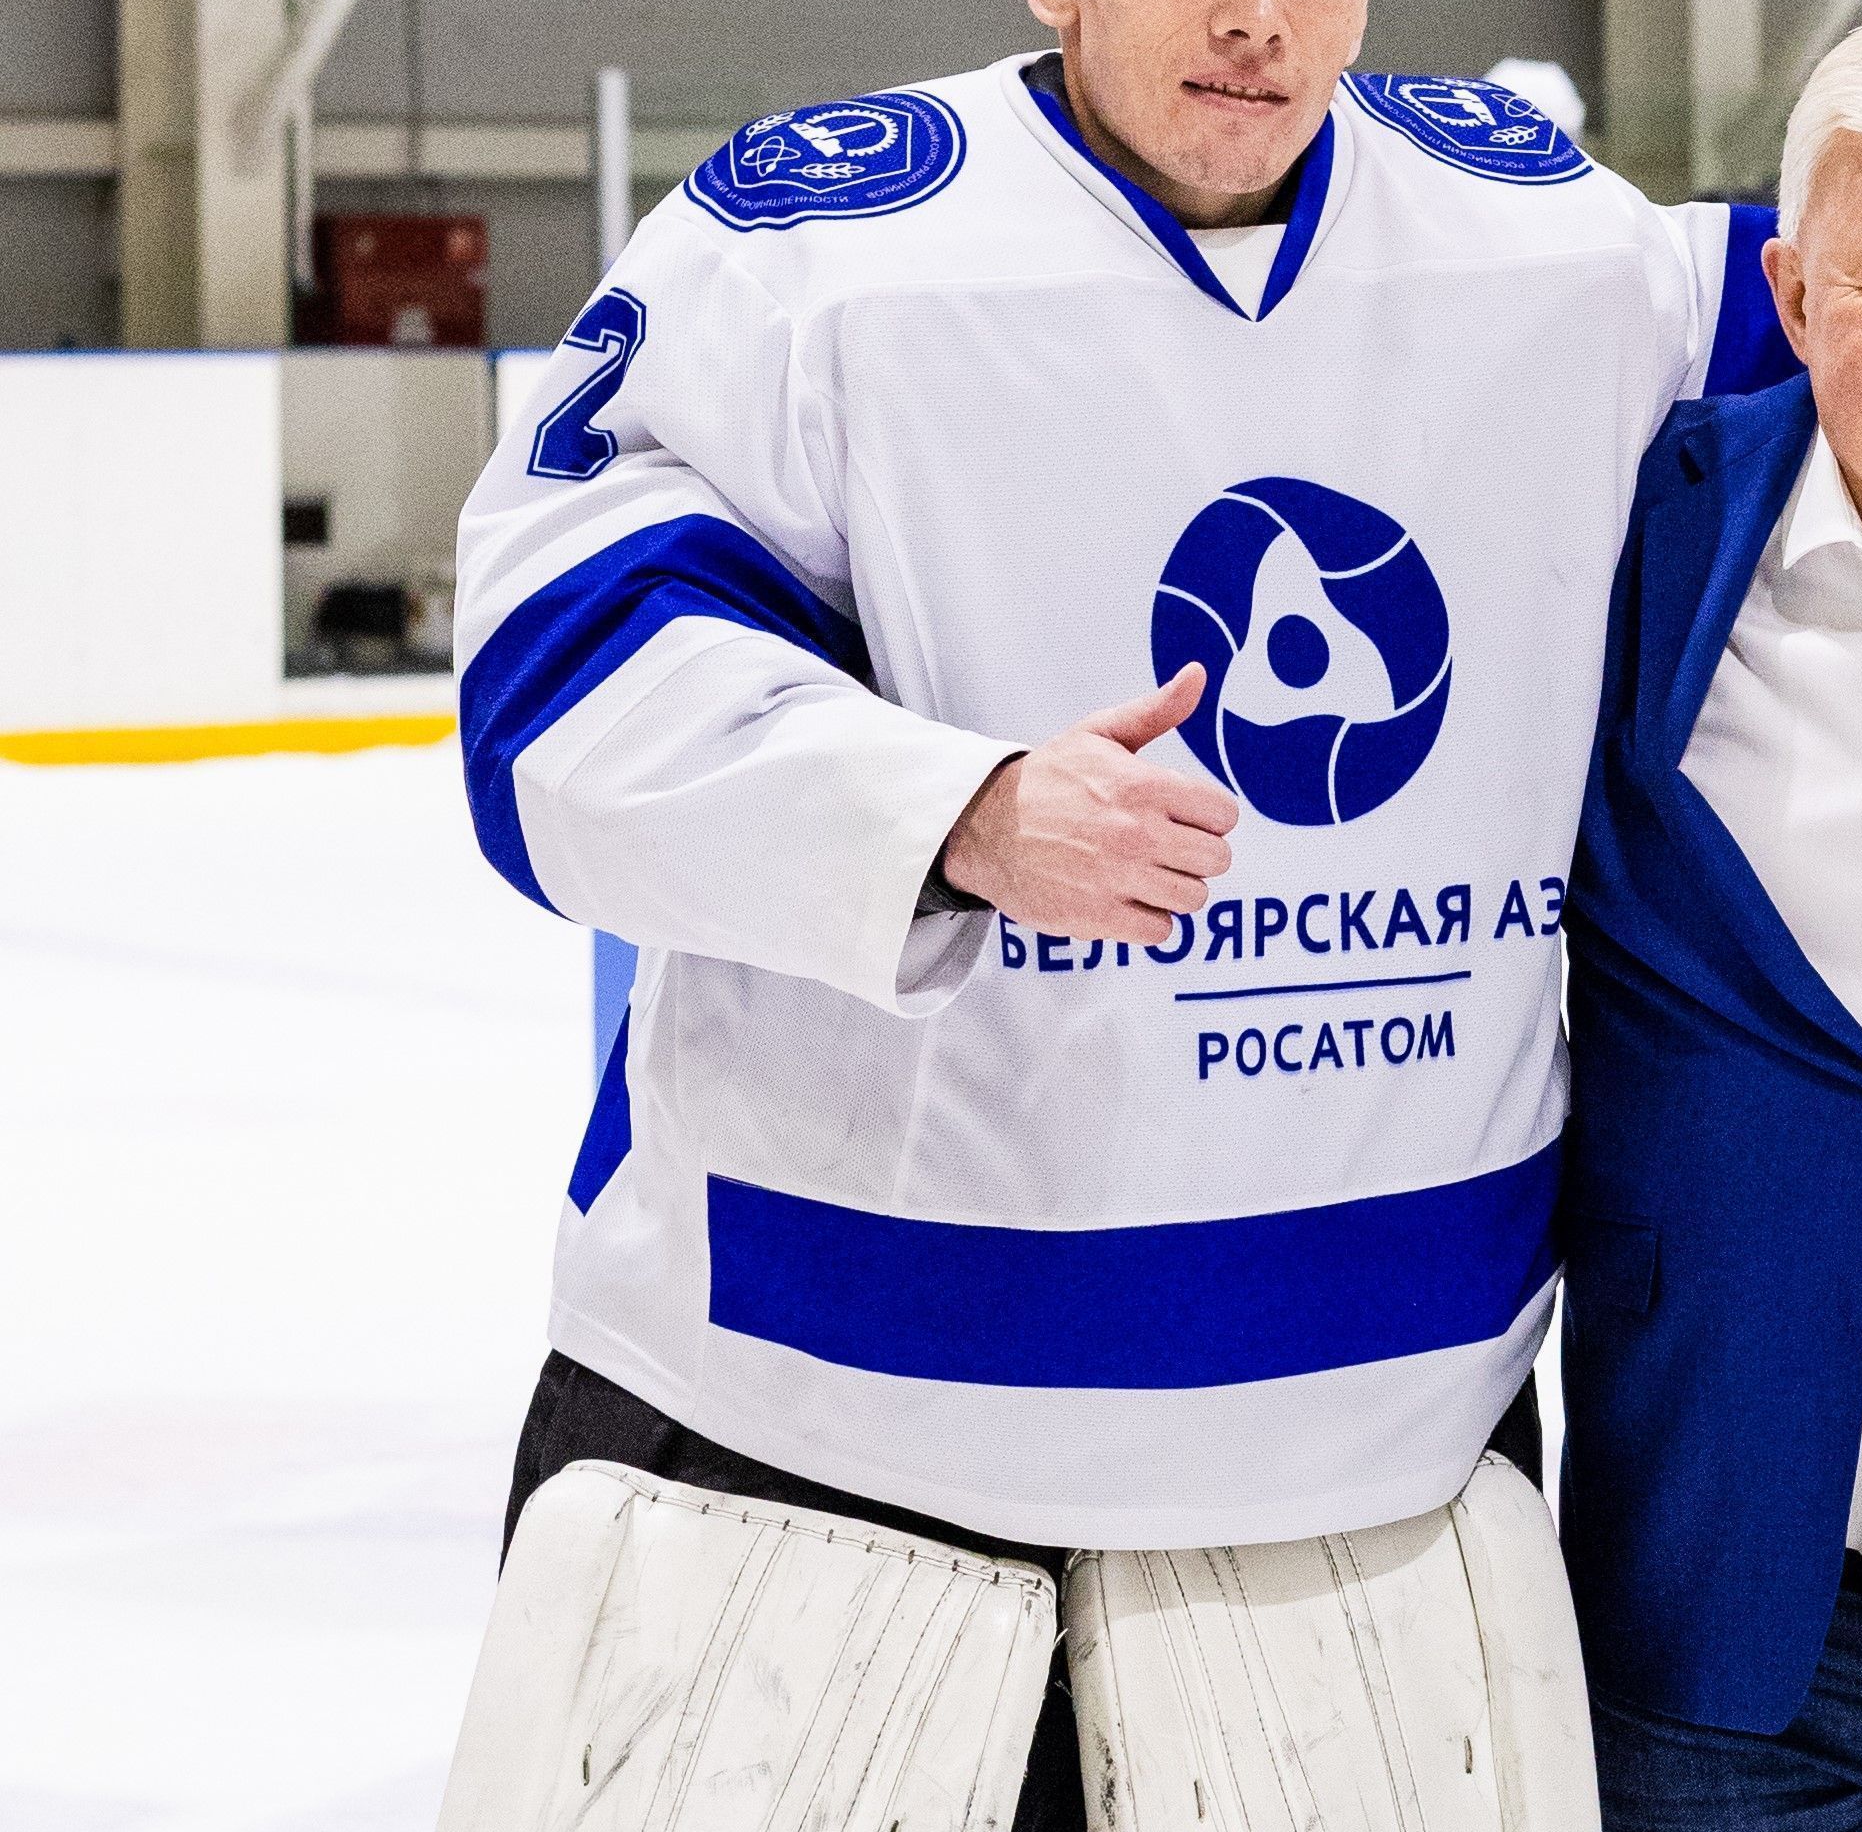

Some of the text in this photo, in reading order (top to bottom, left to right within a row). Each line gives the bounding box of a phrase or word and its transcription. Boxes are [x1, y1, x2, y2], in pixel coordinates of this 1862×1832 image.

[526, 285, 648, 481] 2
[1000, 882, 1473, 974] БЕЛОЯРСКАЯ
[1197, 1010, 1457, 1081] РОСАТОМ
